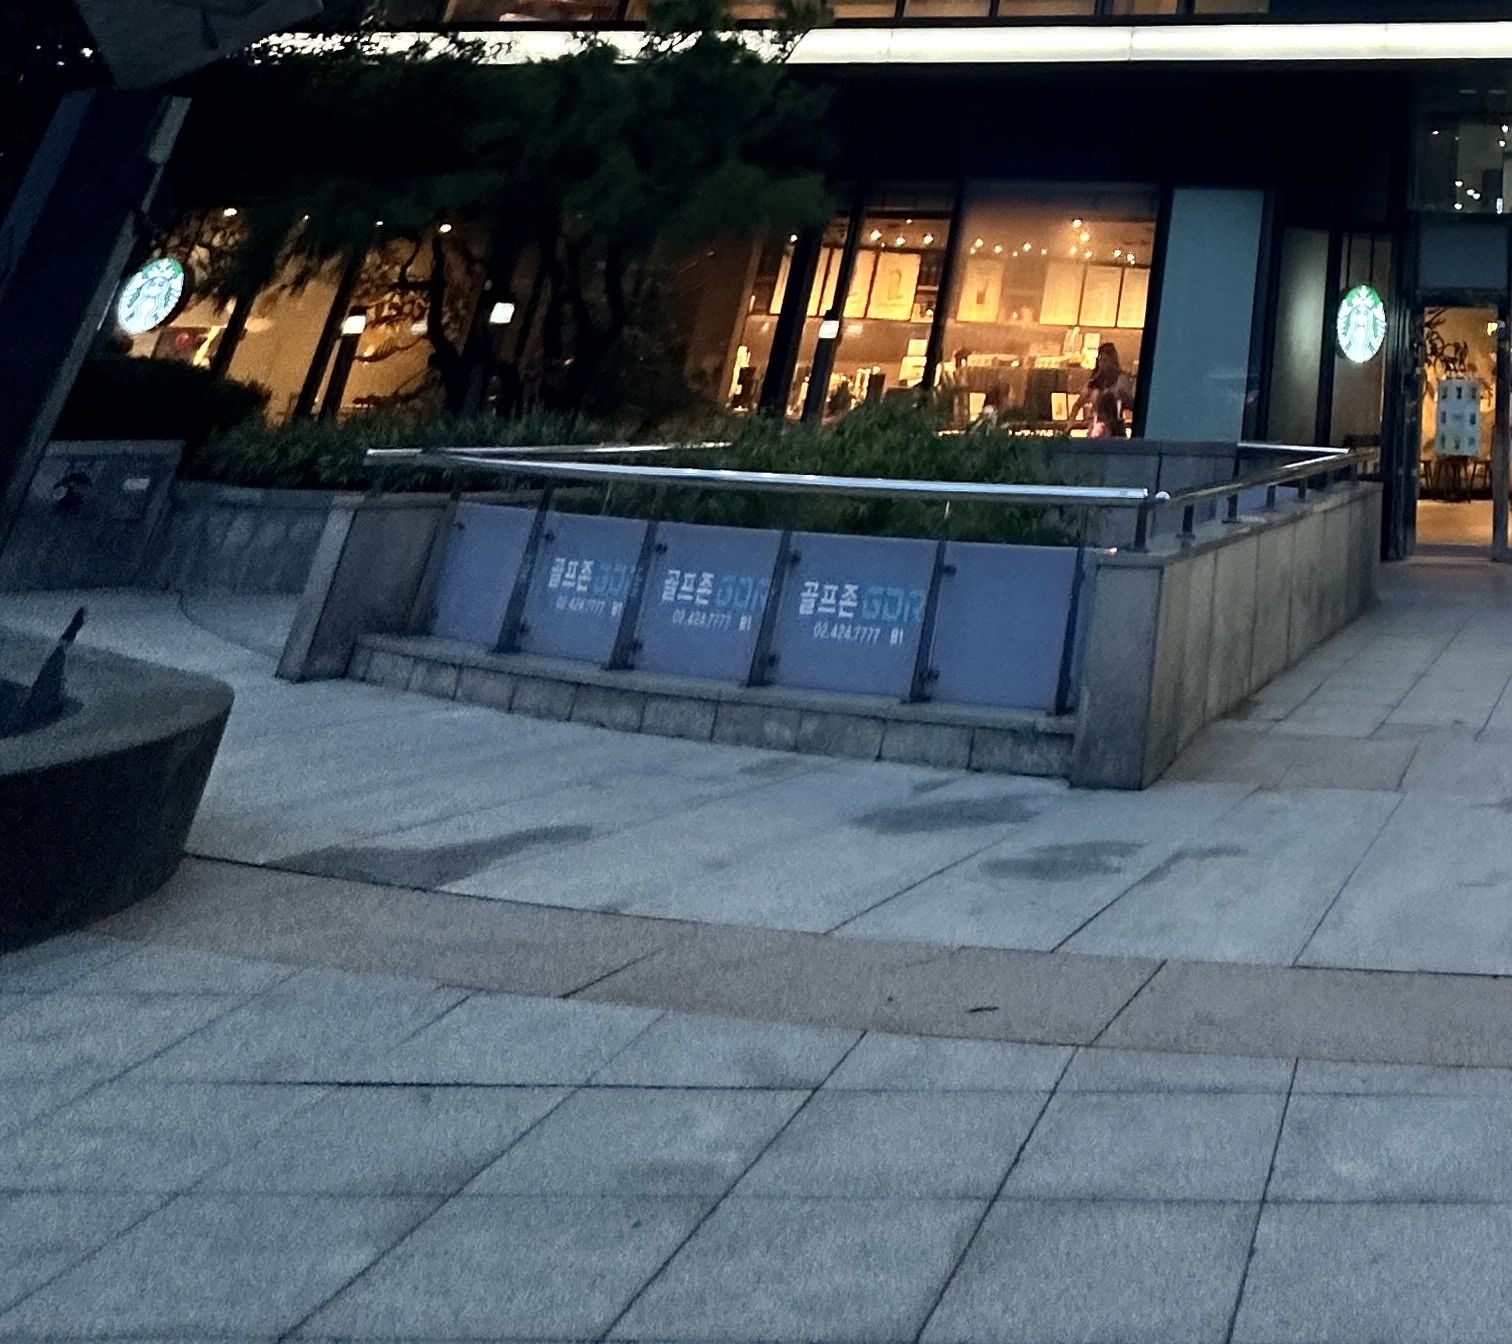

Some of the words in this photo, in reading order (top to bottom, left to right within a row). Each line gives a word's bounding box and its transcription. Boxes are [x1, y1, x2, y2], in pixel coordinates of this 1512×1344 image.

[548, 557, 595, 592] 골프존
[660, 568, 715, 606] 골프존
[798, 579, 860, 619] 골프존
